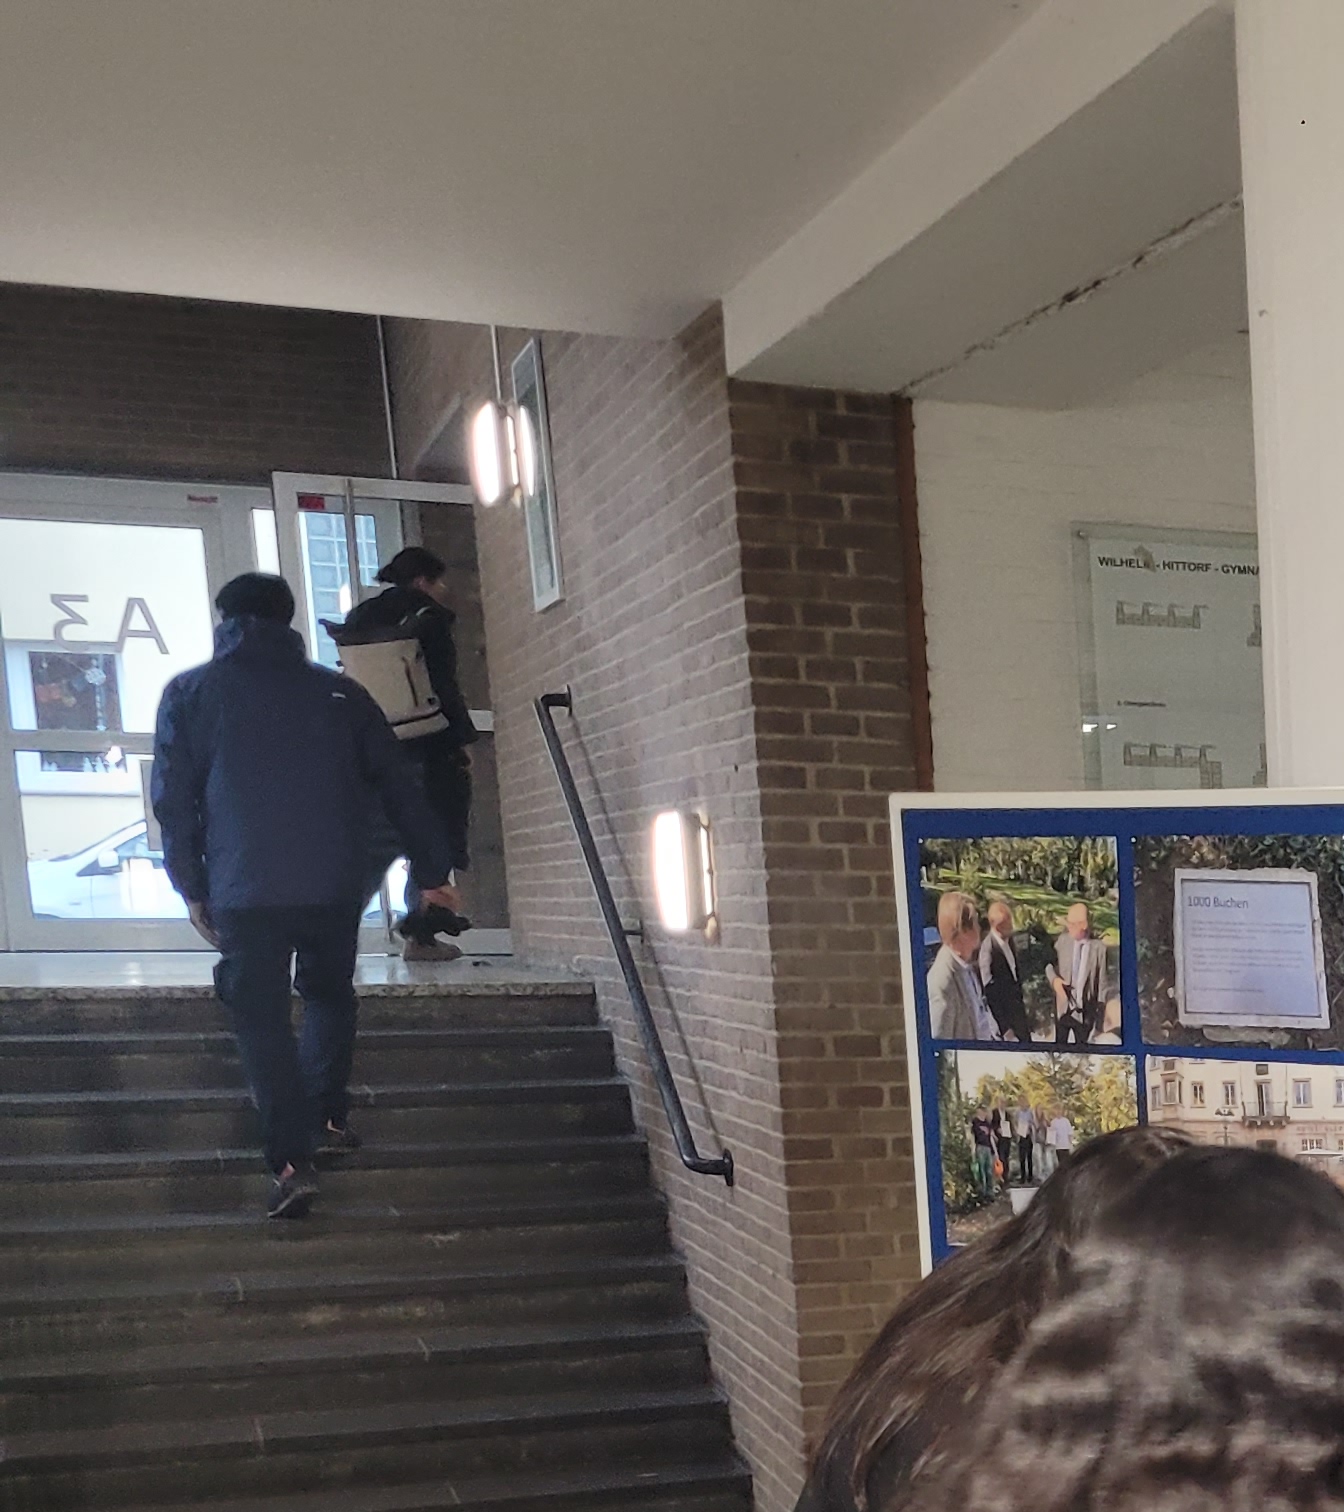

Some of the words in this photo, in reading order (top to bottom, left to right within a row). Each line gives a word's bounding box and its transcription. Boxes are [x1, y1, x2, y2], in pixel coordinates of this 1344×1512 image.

[1162, 560, 1211, 573] HITTORF
[1188, 896, 1211, 908] 1000
[1213, 897, 1249, 909] Buchen
